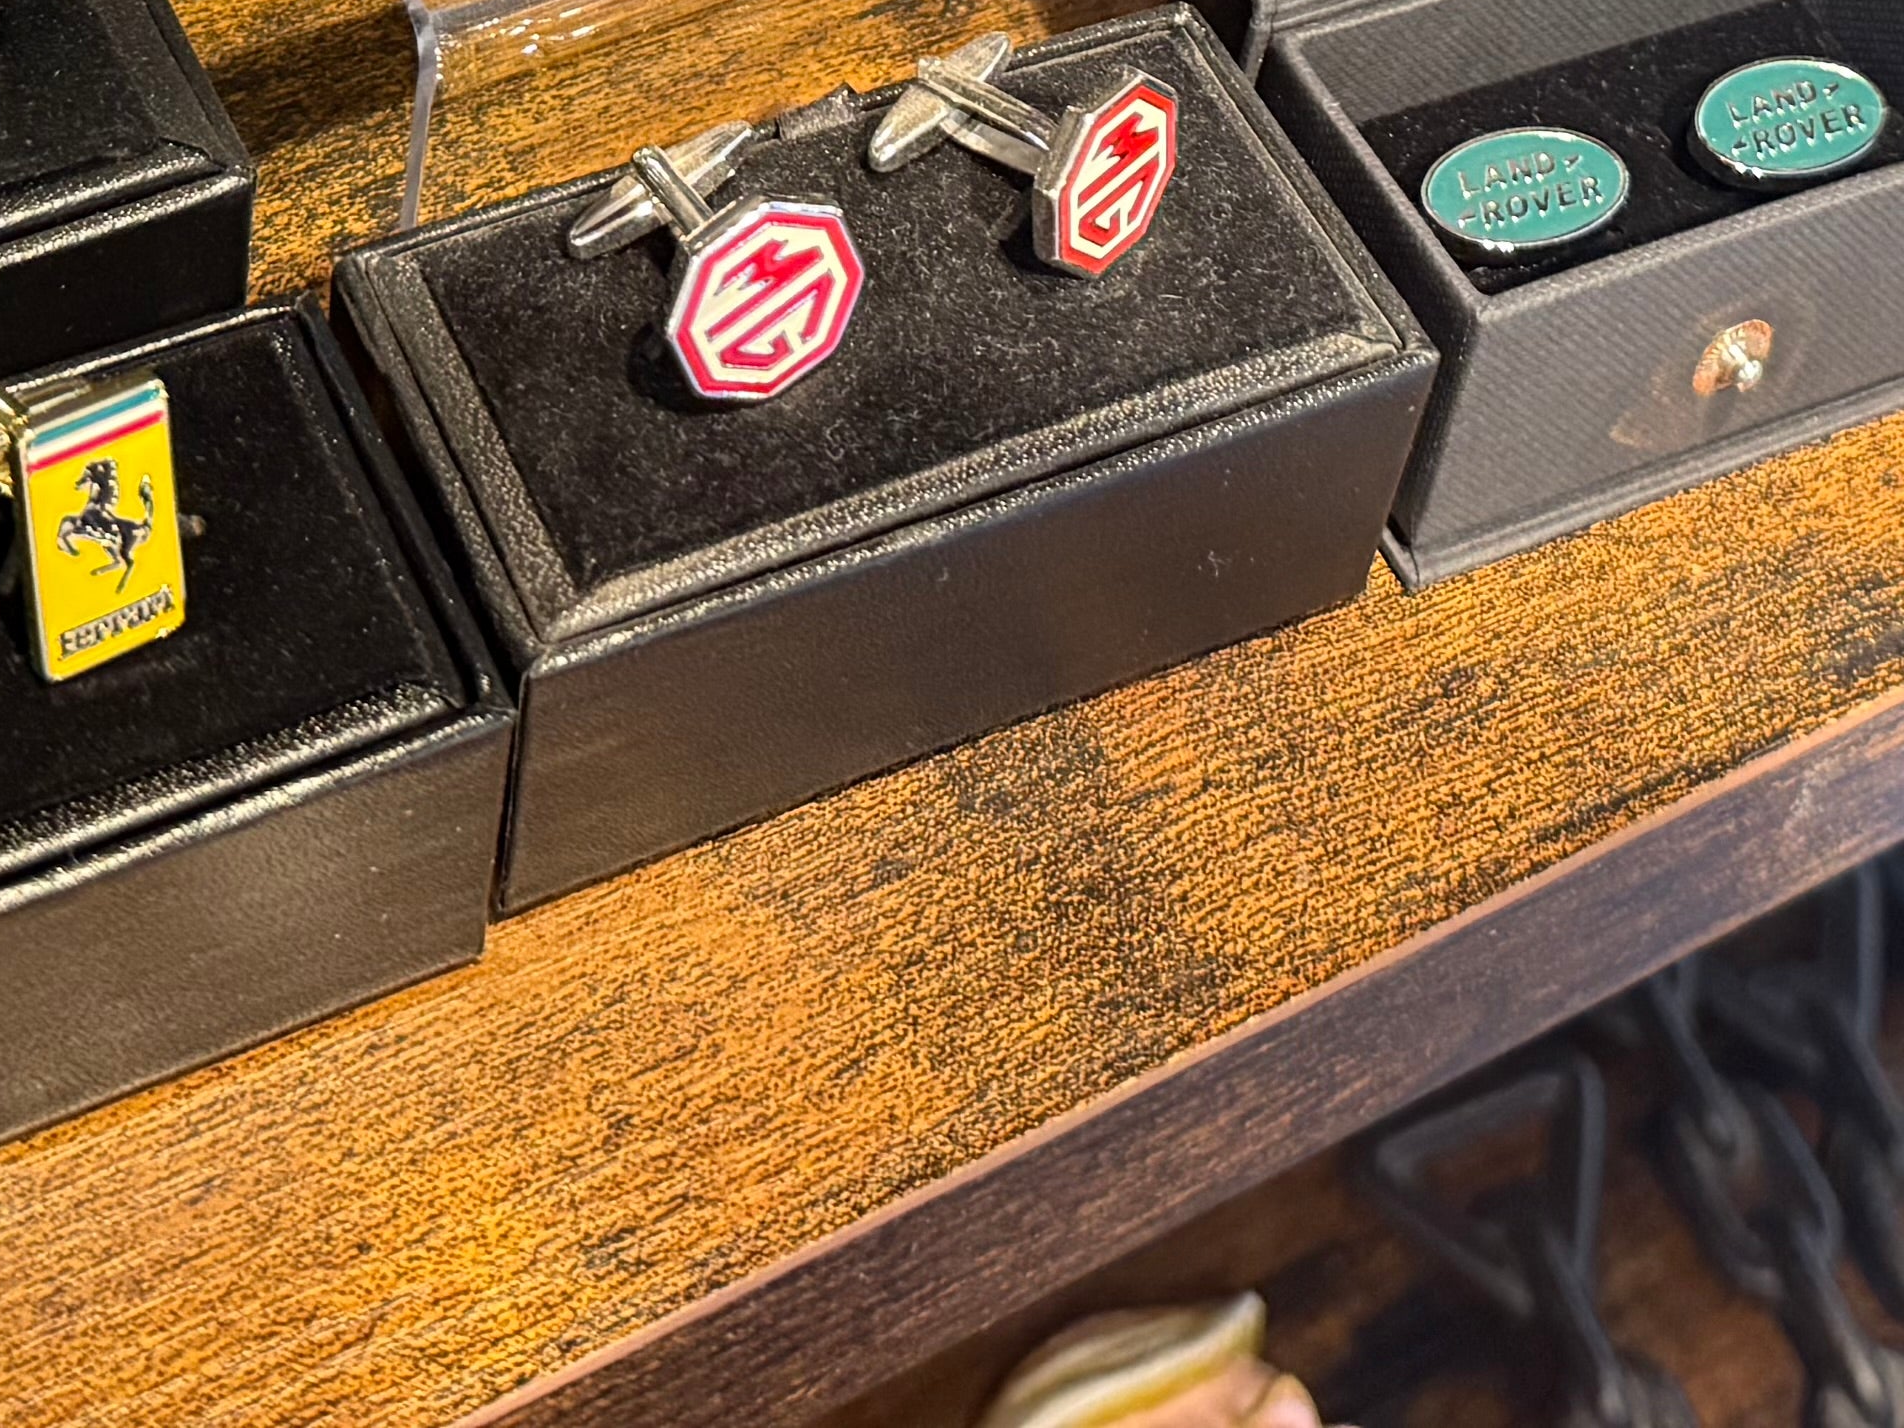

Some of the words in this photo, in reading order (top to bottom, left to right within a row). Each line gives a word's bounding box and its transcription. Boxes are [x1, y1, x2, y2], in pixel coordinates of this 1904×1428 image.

[1725, 80, 1818, 129] LAND
[1752, 103, 1868, 161] ROVER
[1078, 112, 1160, 244] MG
[1456, 152, 1556, 200] LAND
[1480, 175, 1605, 231] ROVER
[705, 240, 835, 370] MG
